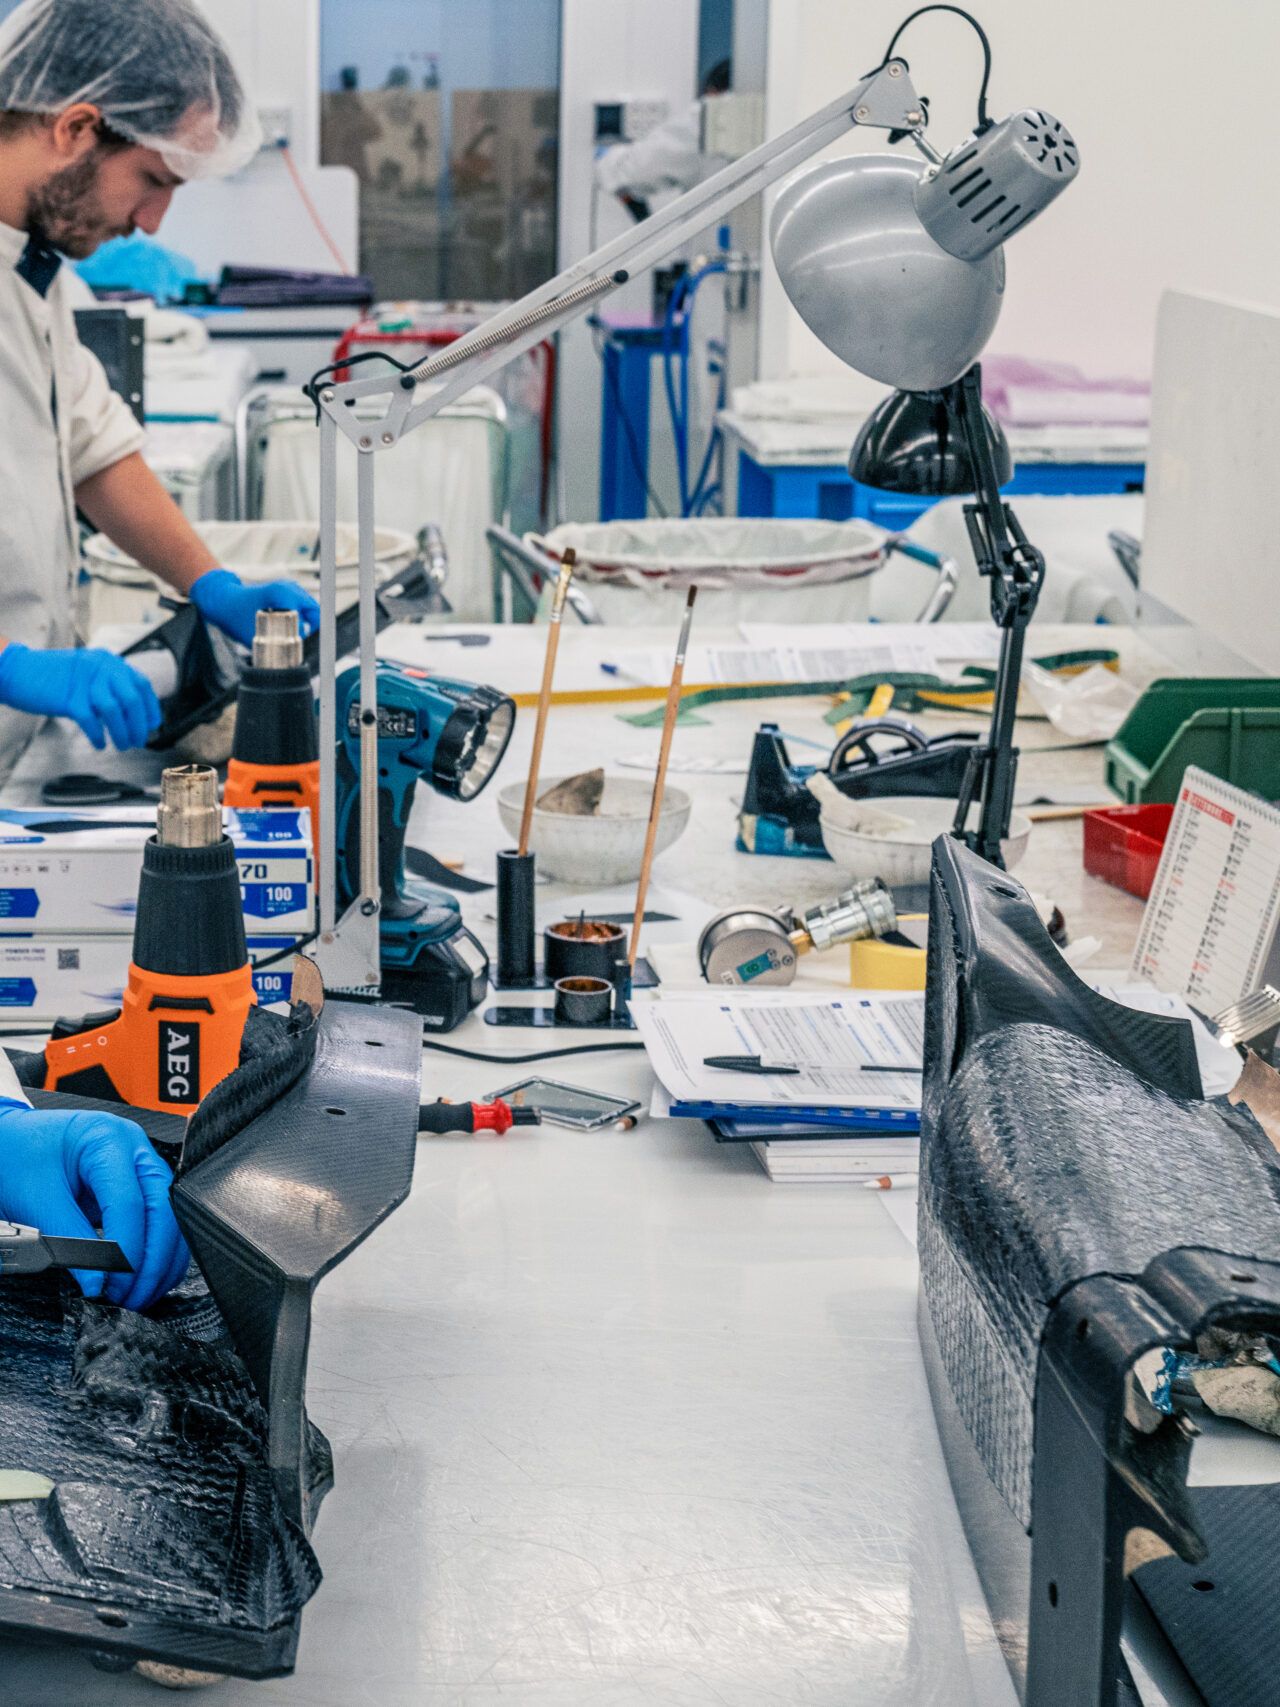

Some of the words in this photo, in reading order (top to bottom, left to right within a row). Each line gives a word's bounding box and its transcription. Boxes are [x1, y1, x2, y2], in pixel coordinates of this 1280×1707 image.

[240, 863, 268, 880] 70
[266, 886, 293, 902] 100
[255, 975, 282, 991] 100
[166, 1027, 191, 1098] AEG
